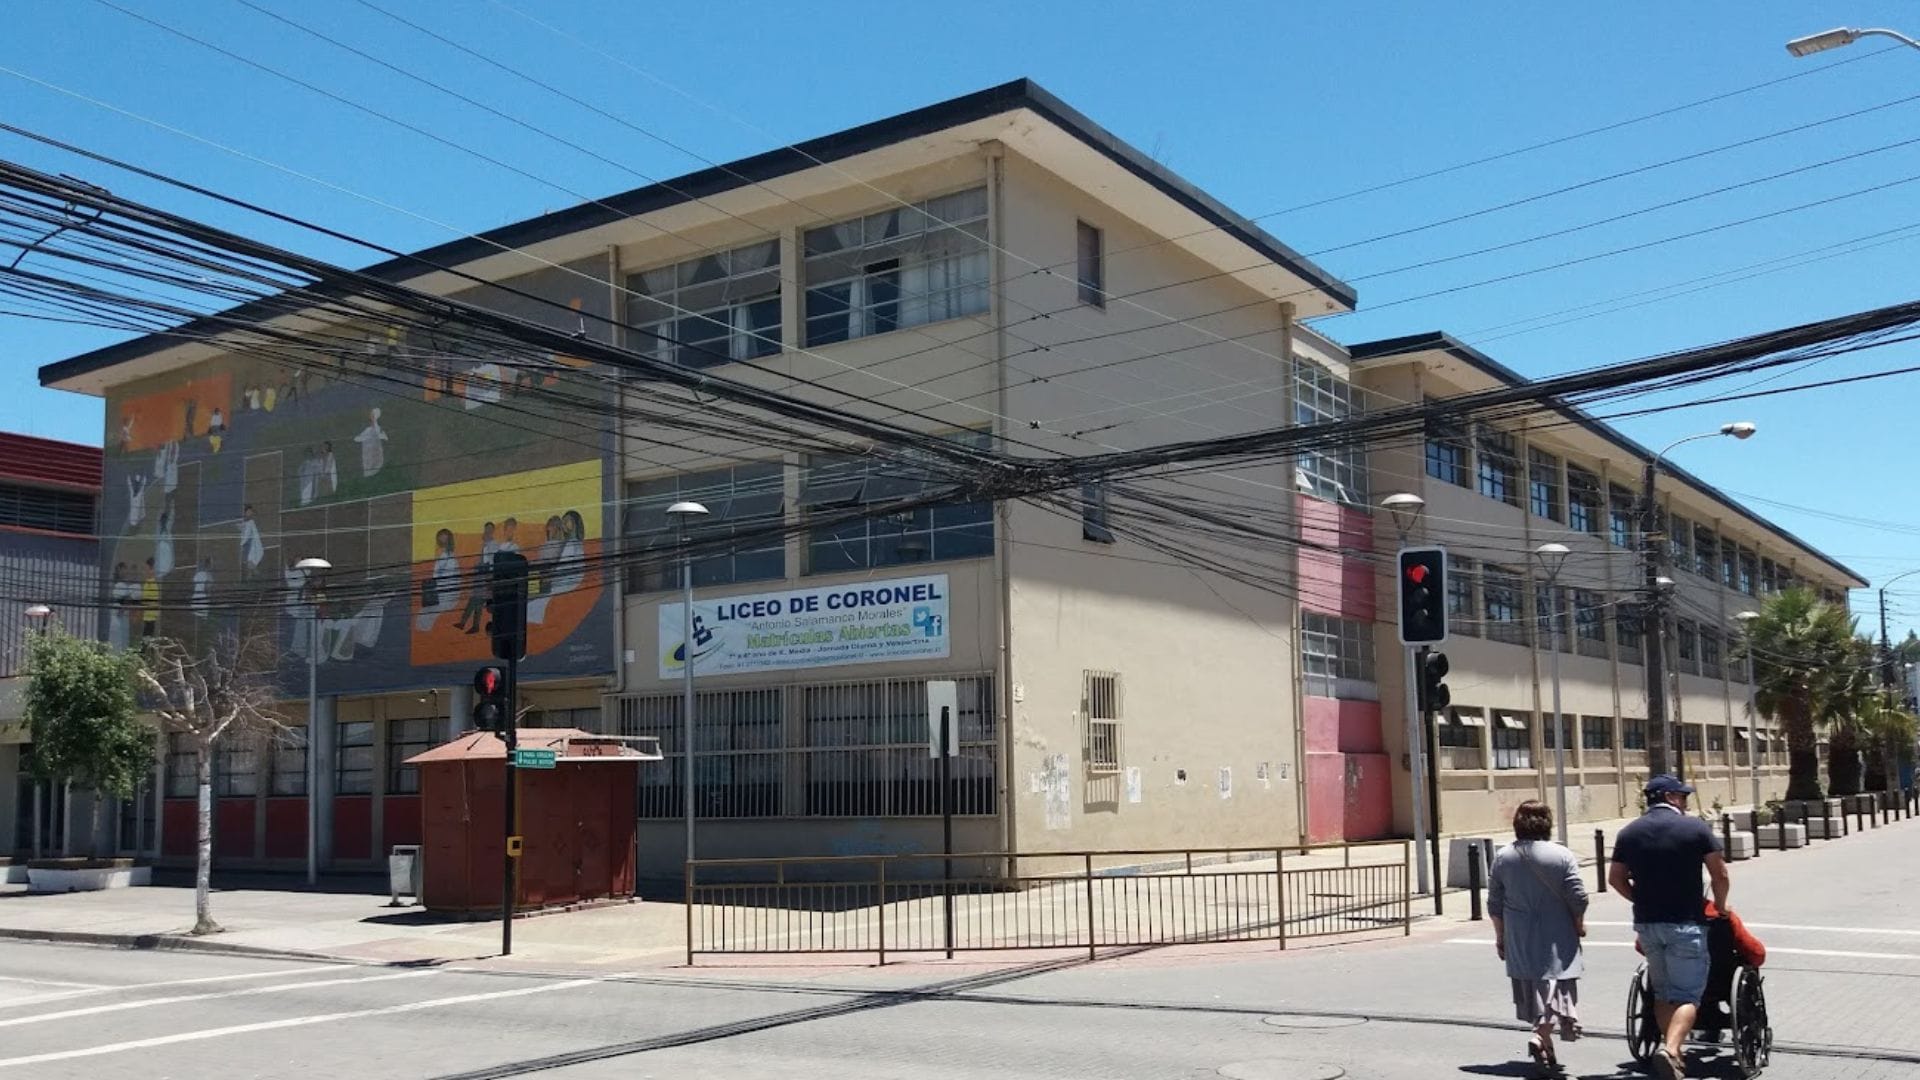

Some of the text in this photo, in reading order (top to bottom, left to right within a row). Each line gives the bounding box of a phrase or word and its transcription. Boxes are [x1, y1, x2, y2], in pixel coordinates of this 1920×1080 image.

[717, 583, 942, 621] LICEO DE CORONEL
[794, 613, 855, 628] Salamanca
[840, 622, 912, 641] Abiertas
